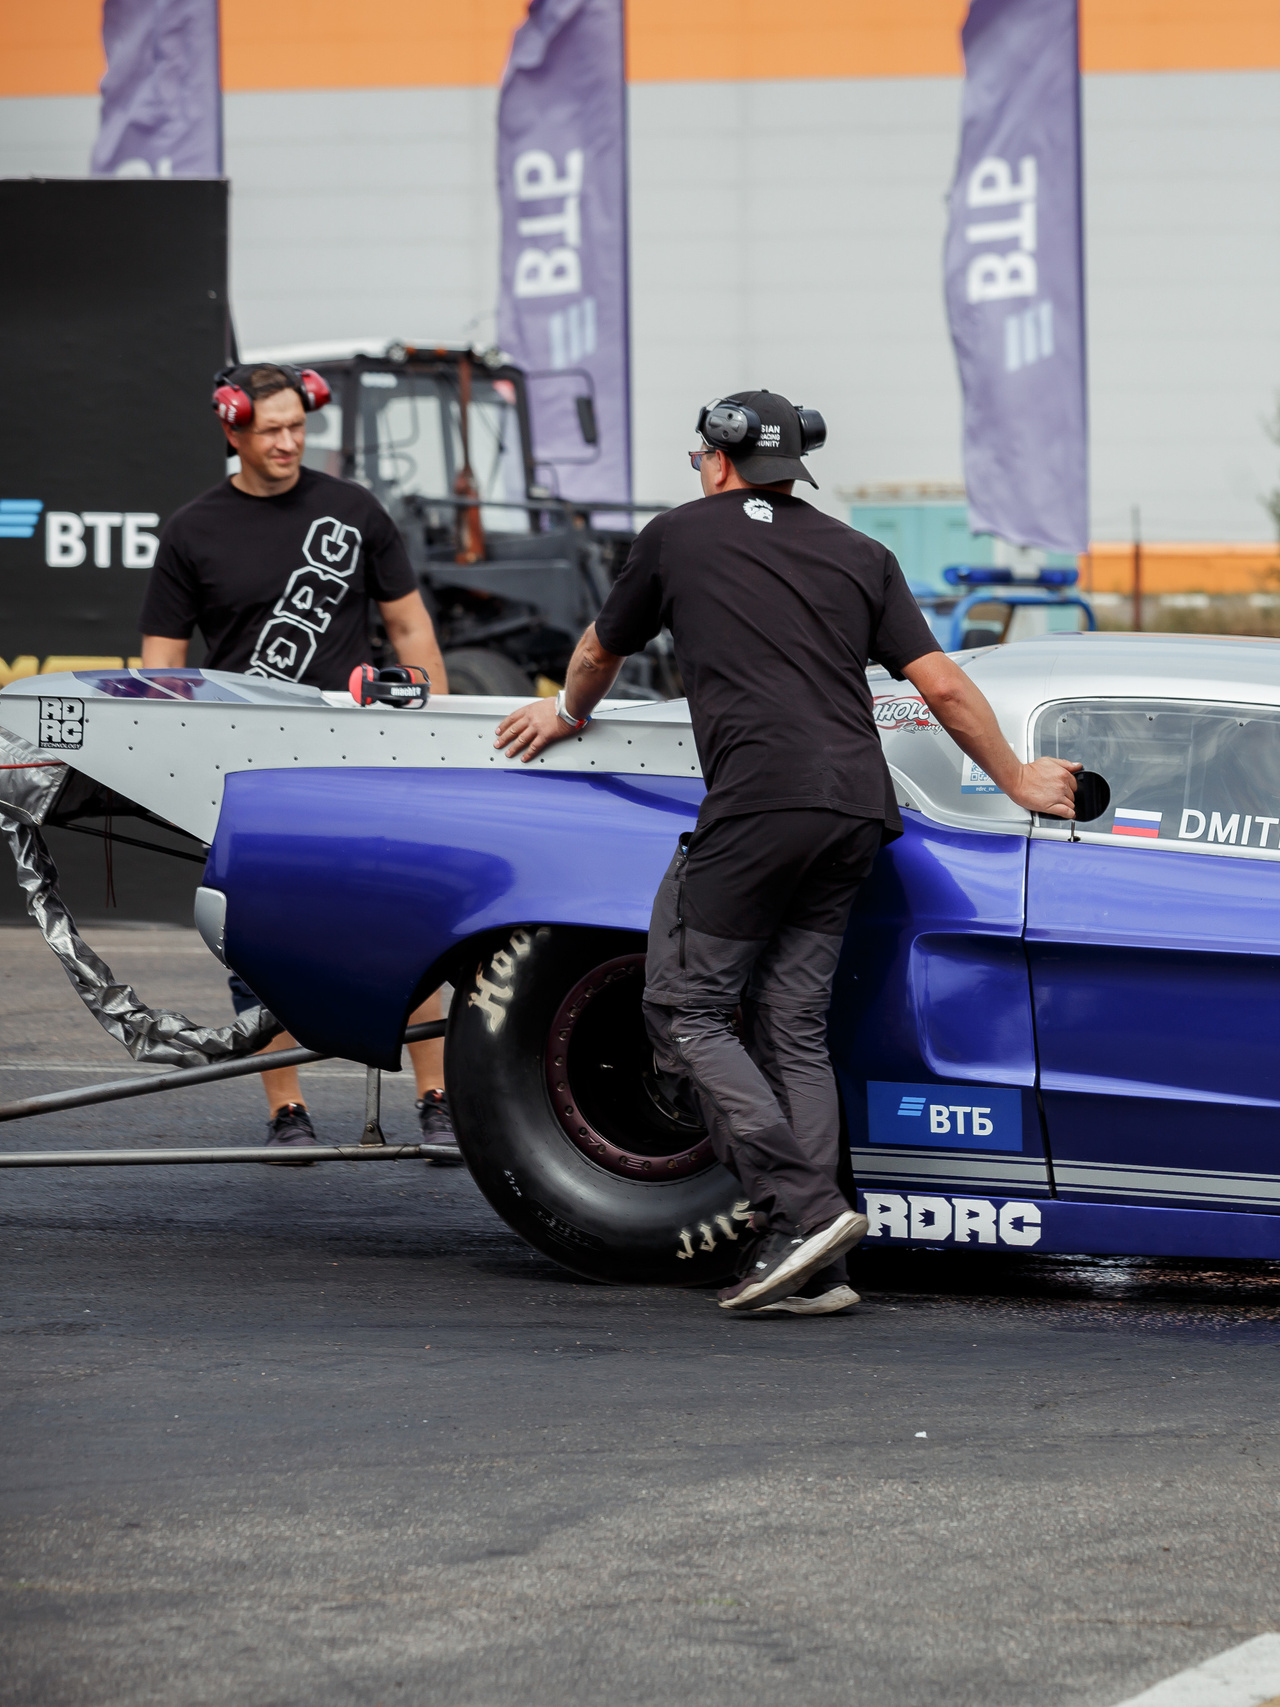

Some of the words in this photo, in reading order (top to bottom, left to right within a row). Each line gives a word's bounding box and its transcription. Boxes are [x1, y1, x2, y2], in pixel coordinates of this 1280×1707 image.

[756, 440, 780, 448] UNITY
[761, 424, 780, 433] SIAN
[46, 511, 160, 569] ВТБ
[244, 516, 362, 684] DRC
[897, 721, 943, 736] Racing
[468, 926, 550, 1033] Hoo
[929, 1104, 994, 1136] ВТБ
[863, 1192, 1042, 1247] RDRC
